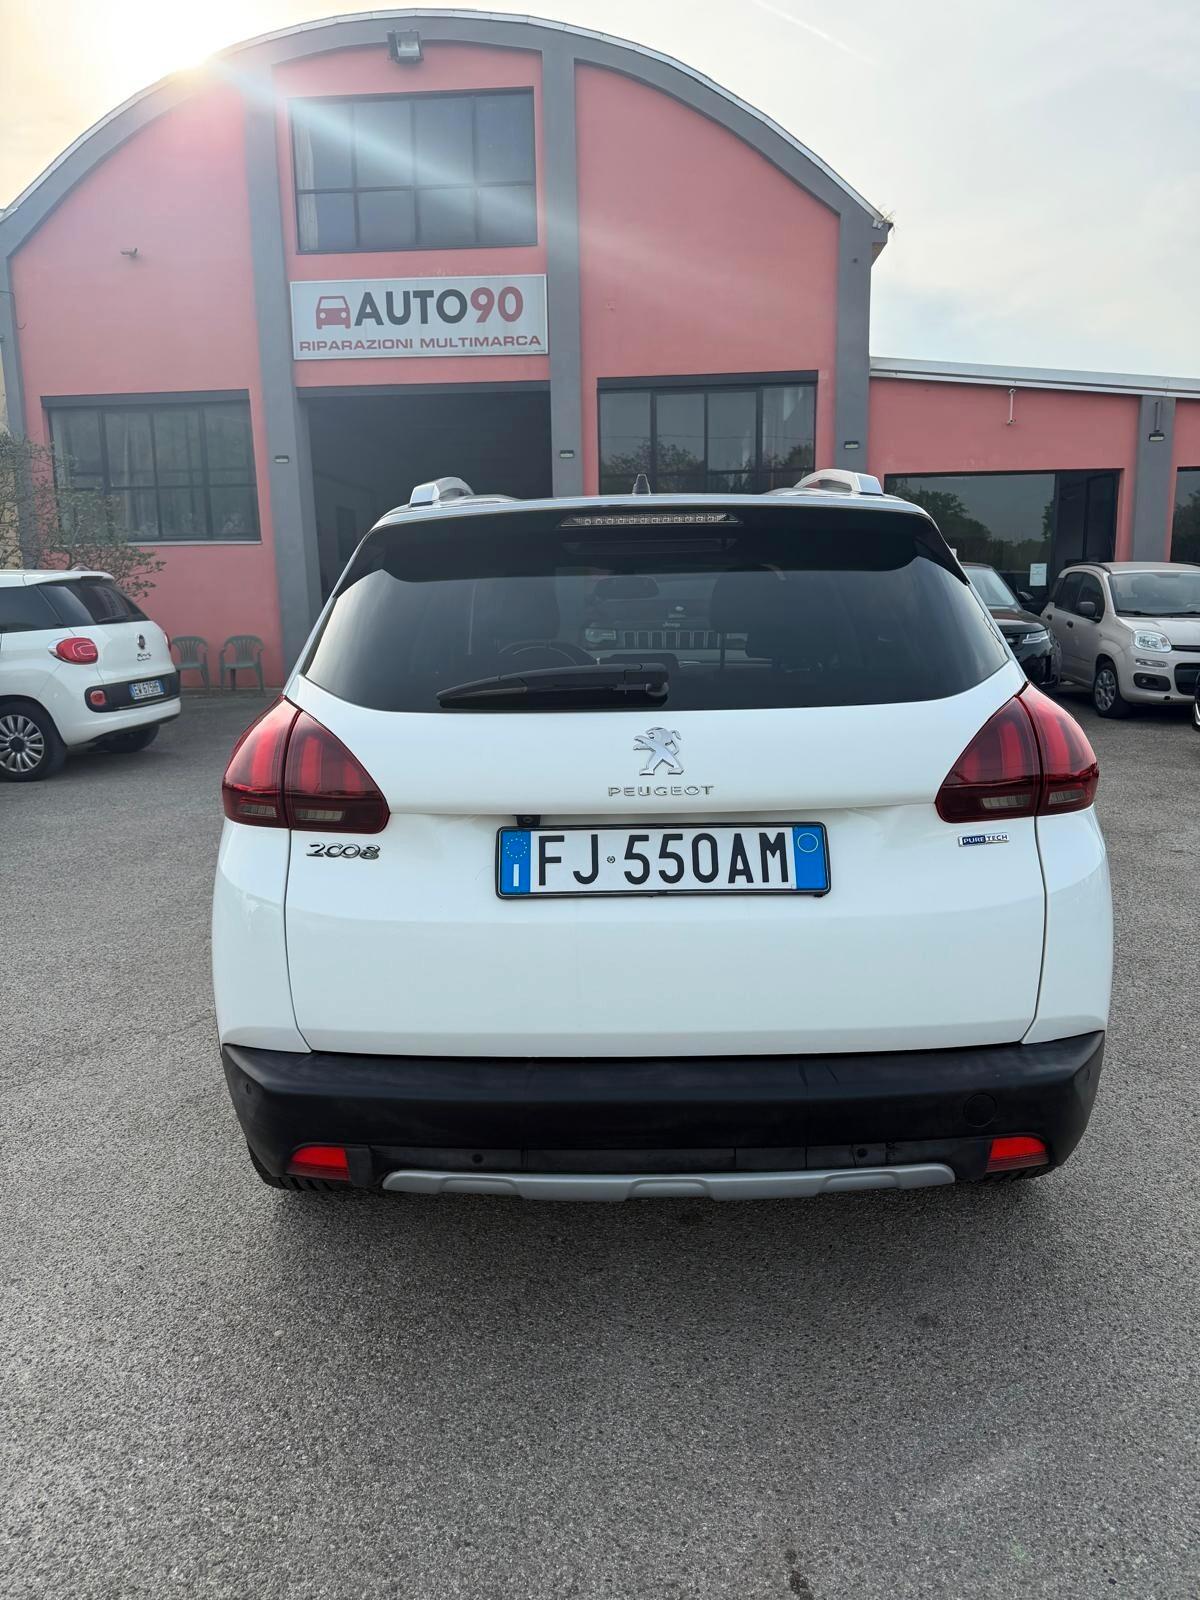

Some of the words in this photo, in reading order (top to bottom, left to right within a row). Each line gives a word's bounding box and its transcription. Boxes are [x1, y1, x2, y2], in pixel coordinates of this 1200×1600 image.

[354, 287, 524, 327] AUTO90
[299, 339, 413, 352] RIPARAZIONI
[420, 335, 542, 349] MULTIMARCA
[608, 785, 714, 797] PEUGEOT
[306, 843, 381, 860] 2008
